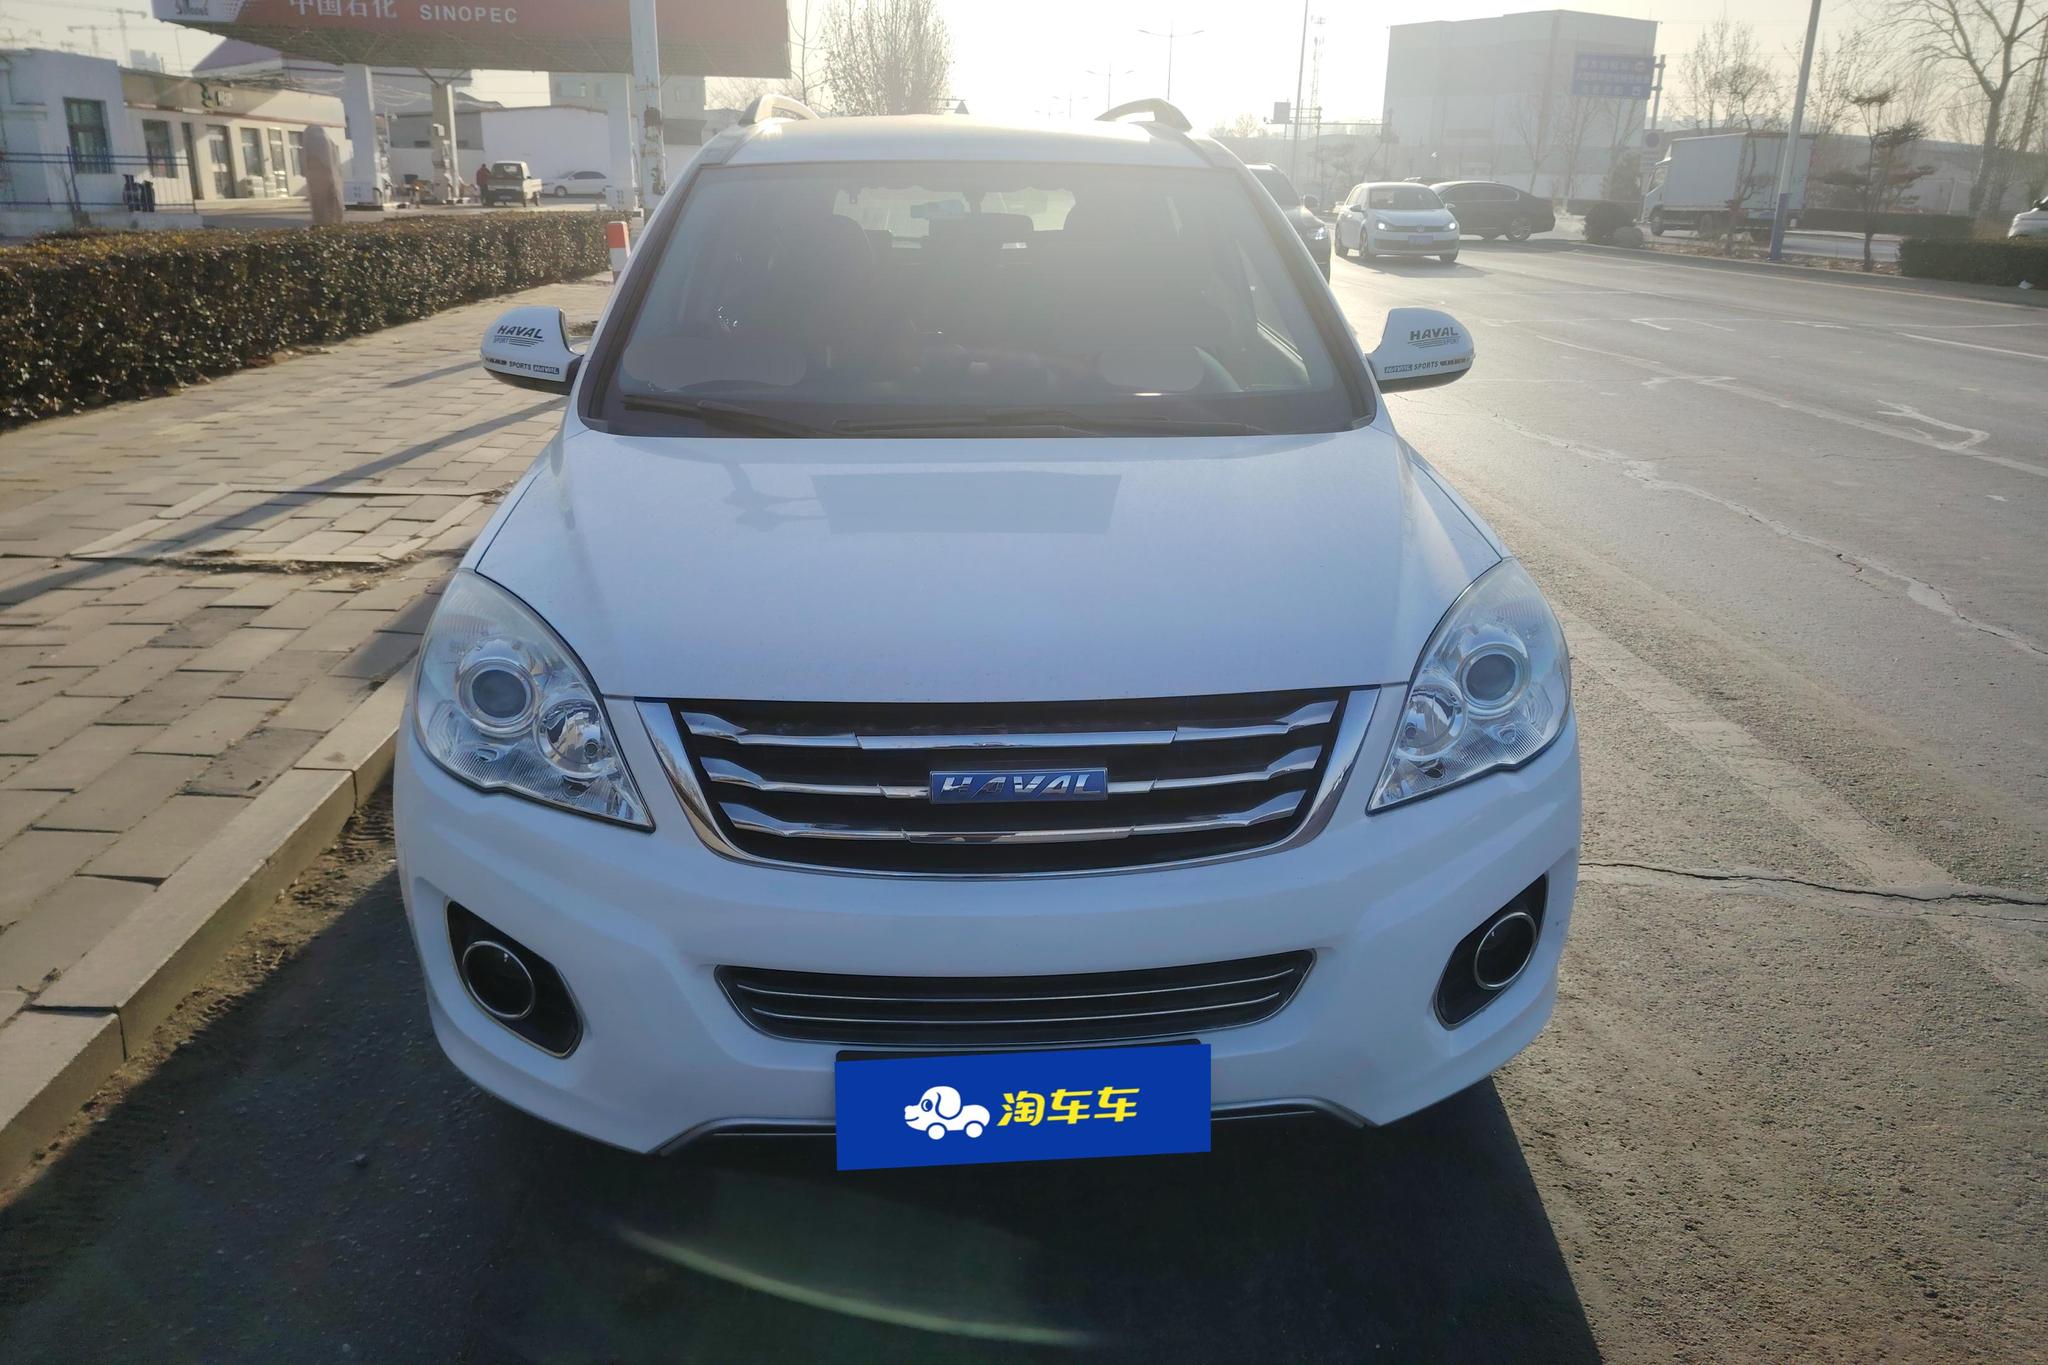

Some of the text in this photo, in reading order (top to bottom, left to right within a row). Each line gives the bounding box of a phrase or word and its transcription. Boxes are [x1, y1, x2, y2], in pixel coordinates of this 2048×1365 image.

[419, 4, 518, 23] SINOPEC
[497, 325, 543, 339] HAVAL
[1410, 326, 1459, 341] HAVAL
[509, 361, 532, 371] SPORTS
[1414, 361, 1439, 371] SPORTS
[940, 774, 1101, 799] HAVAL
